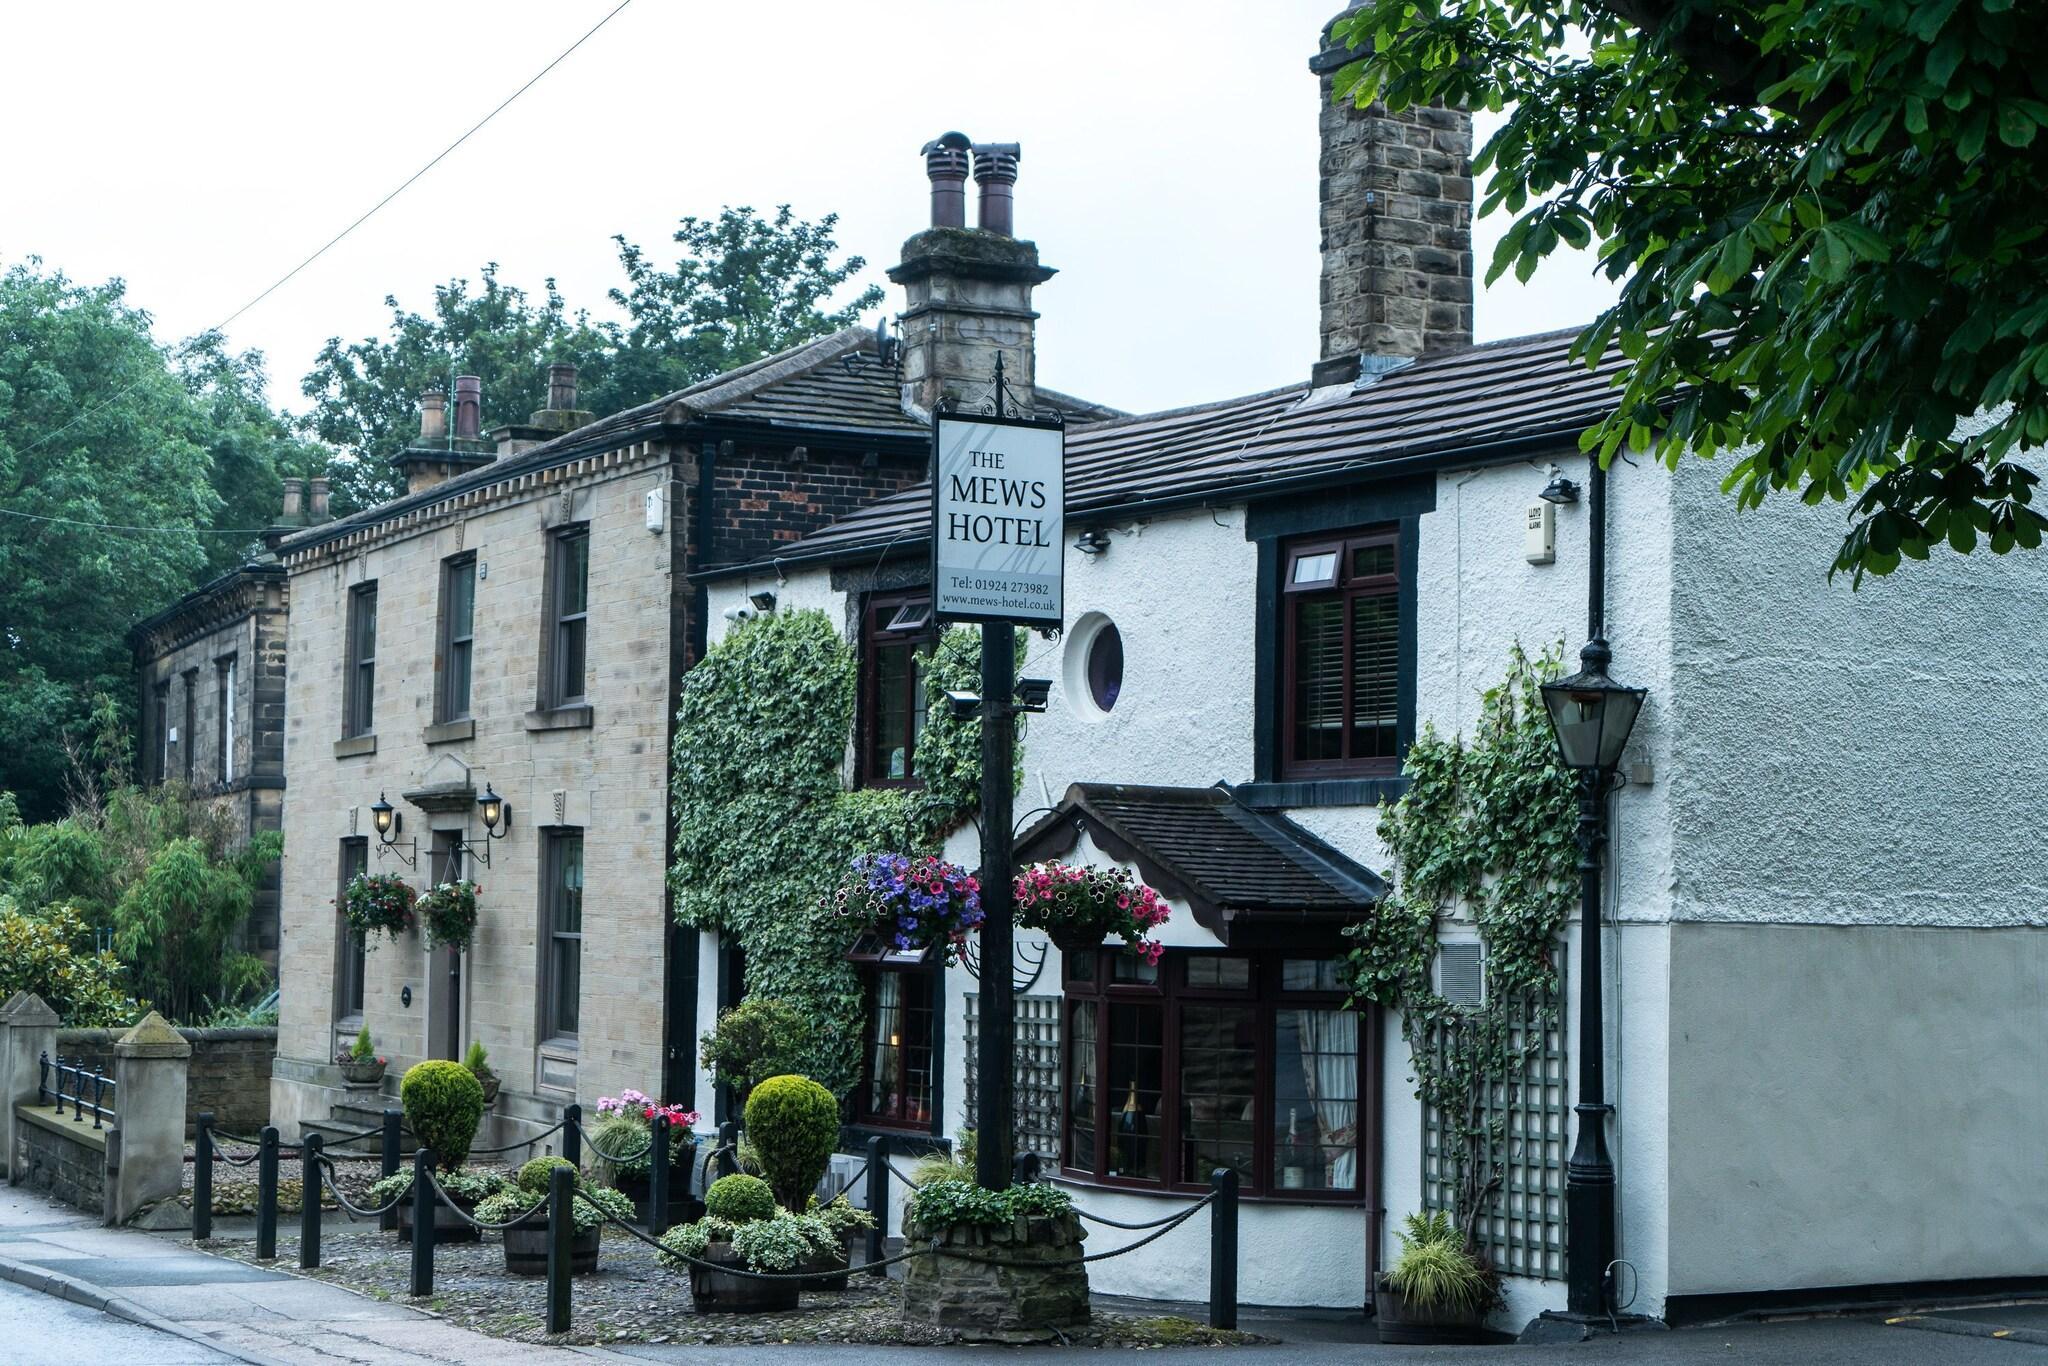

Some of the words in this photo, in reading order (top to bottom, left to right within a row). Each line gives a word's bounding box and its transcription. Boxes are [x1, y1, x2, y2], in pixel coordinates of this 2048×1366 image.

[969, 451, 1005, 469] THE
[950, 474, 1046, 509] MEWS
[948, 513, 1050, 548] HOTEL
[951, 576, 972, 589] Tel:
[975, 579, 1007, 591] 01924
[1011, 582, 1049, 595] 273982
[943, 594, 1055, 611] www.mews-hotel.co.uk
